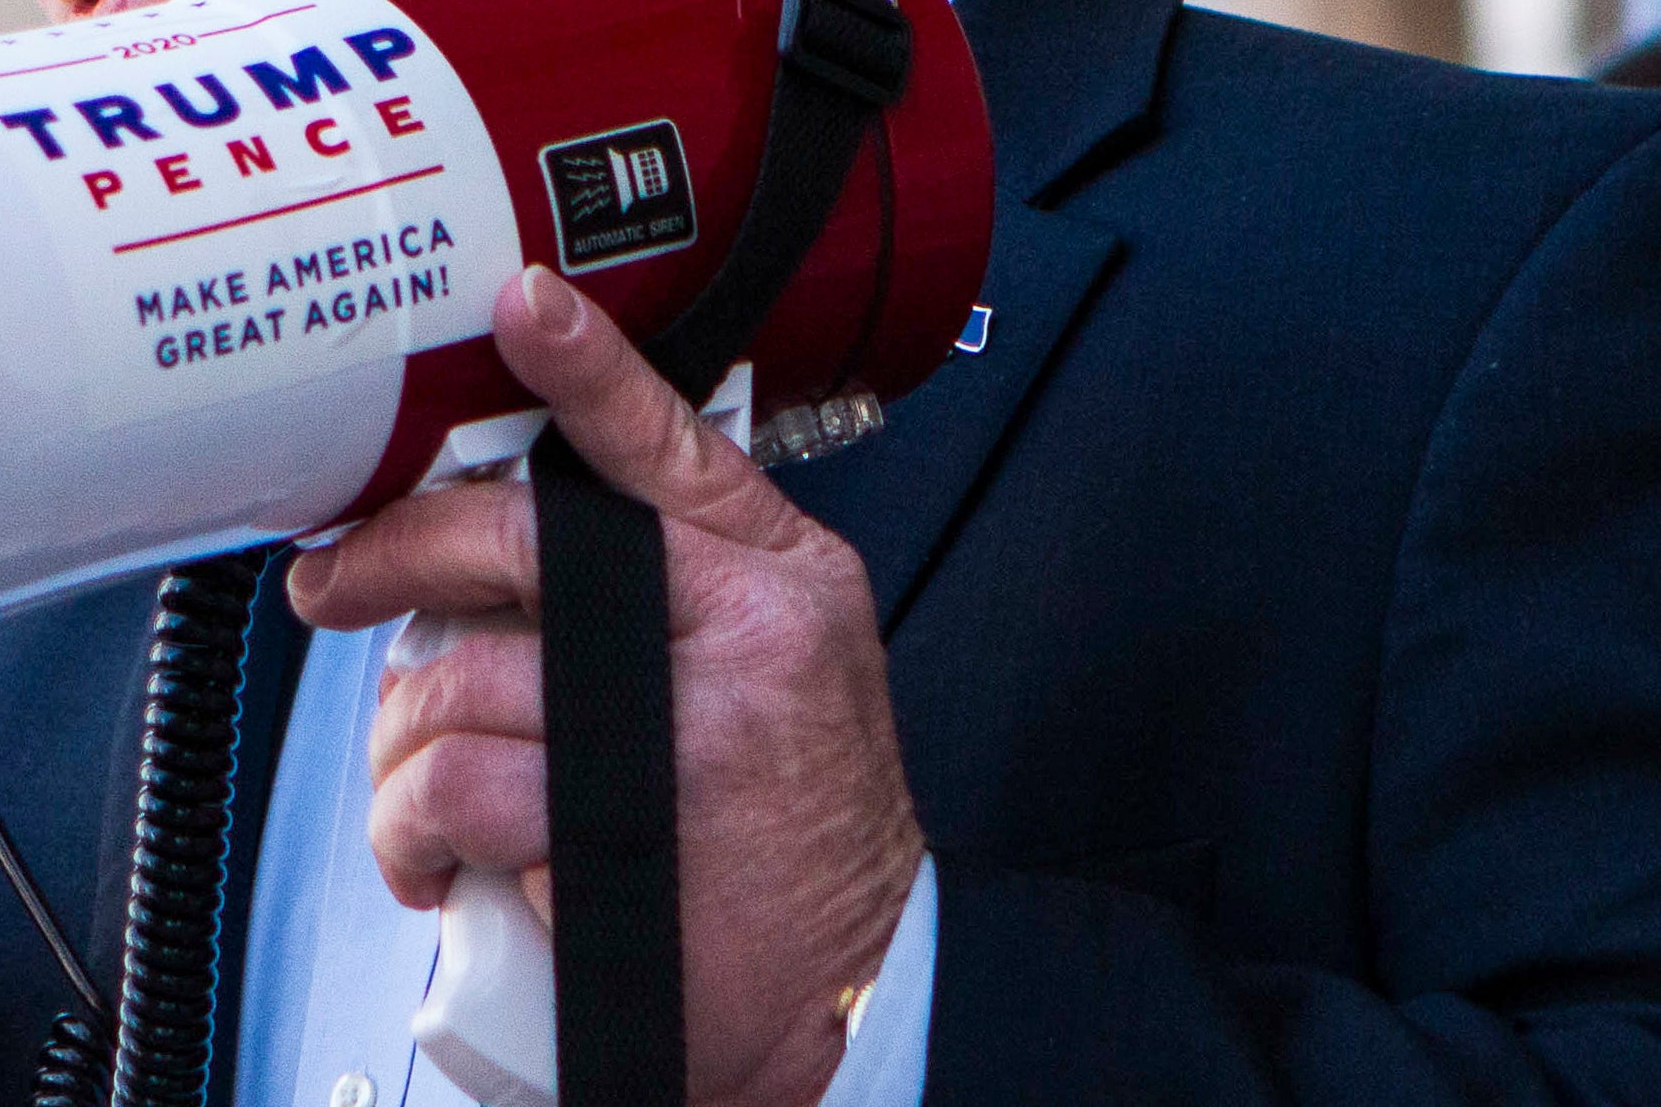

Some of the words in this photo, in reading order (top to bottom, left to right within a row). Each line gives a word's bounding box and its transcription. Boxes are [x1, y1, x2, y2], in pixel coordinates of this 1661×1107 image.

[112, 32, 198, 60] 2020
[81, 95, 426, 211] PENCE
[136, 271, 246, 327] MAKE
[265, 218, 455, 297] AMERICA
[573, 224, 644, 255] AUTOMATIC
[649, 215, 685, 238] SIREN
[155, 309, 286, 370] GREAT
[303, 264, 451, 334] AGAIN!
